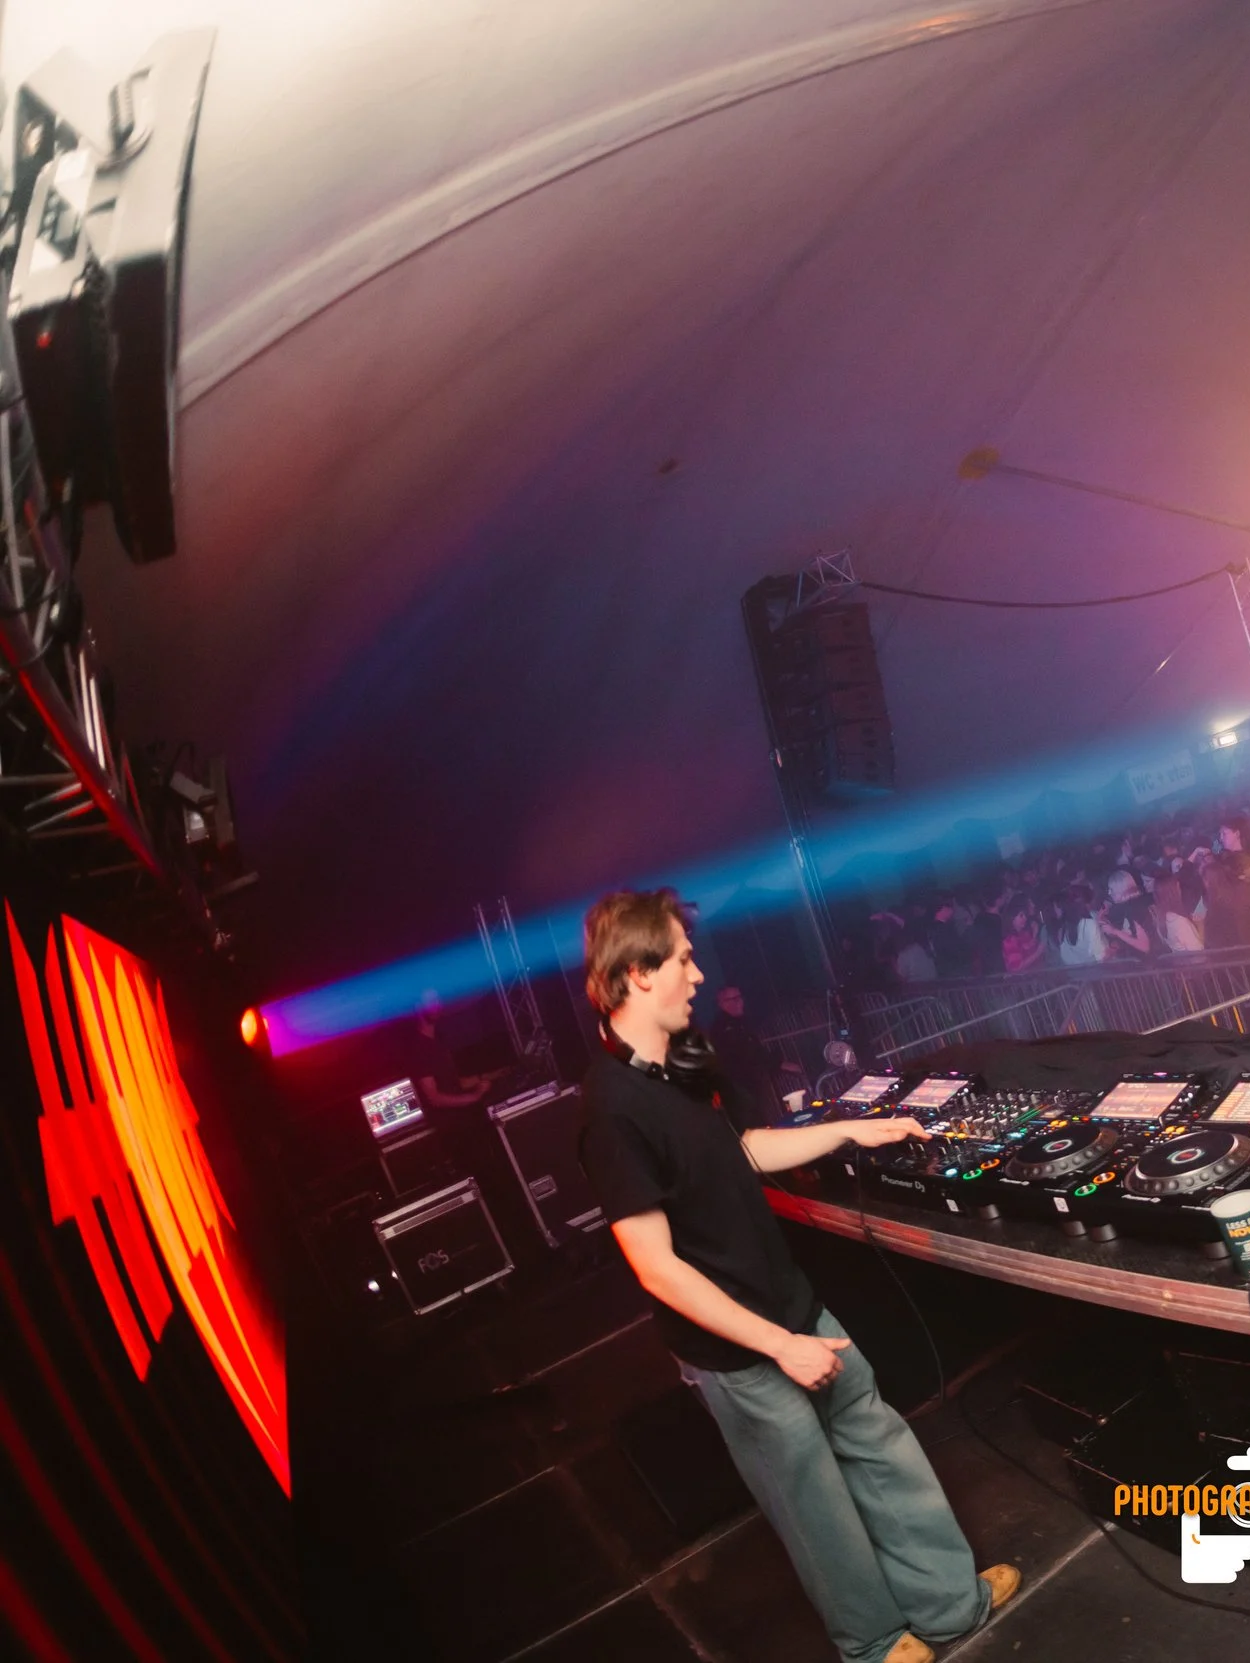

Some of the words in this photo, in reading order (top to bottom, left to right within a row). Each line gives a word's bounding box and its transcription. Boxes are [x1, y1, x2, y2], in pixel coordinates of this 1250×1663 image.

[881, 1174, 913, 1188] Pioneer
[1225, 1219, 1248, 1230] LESS
[417, 1249, 450, 1274] FOS
